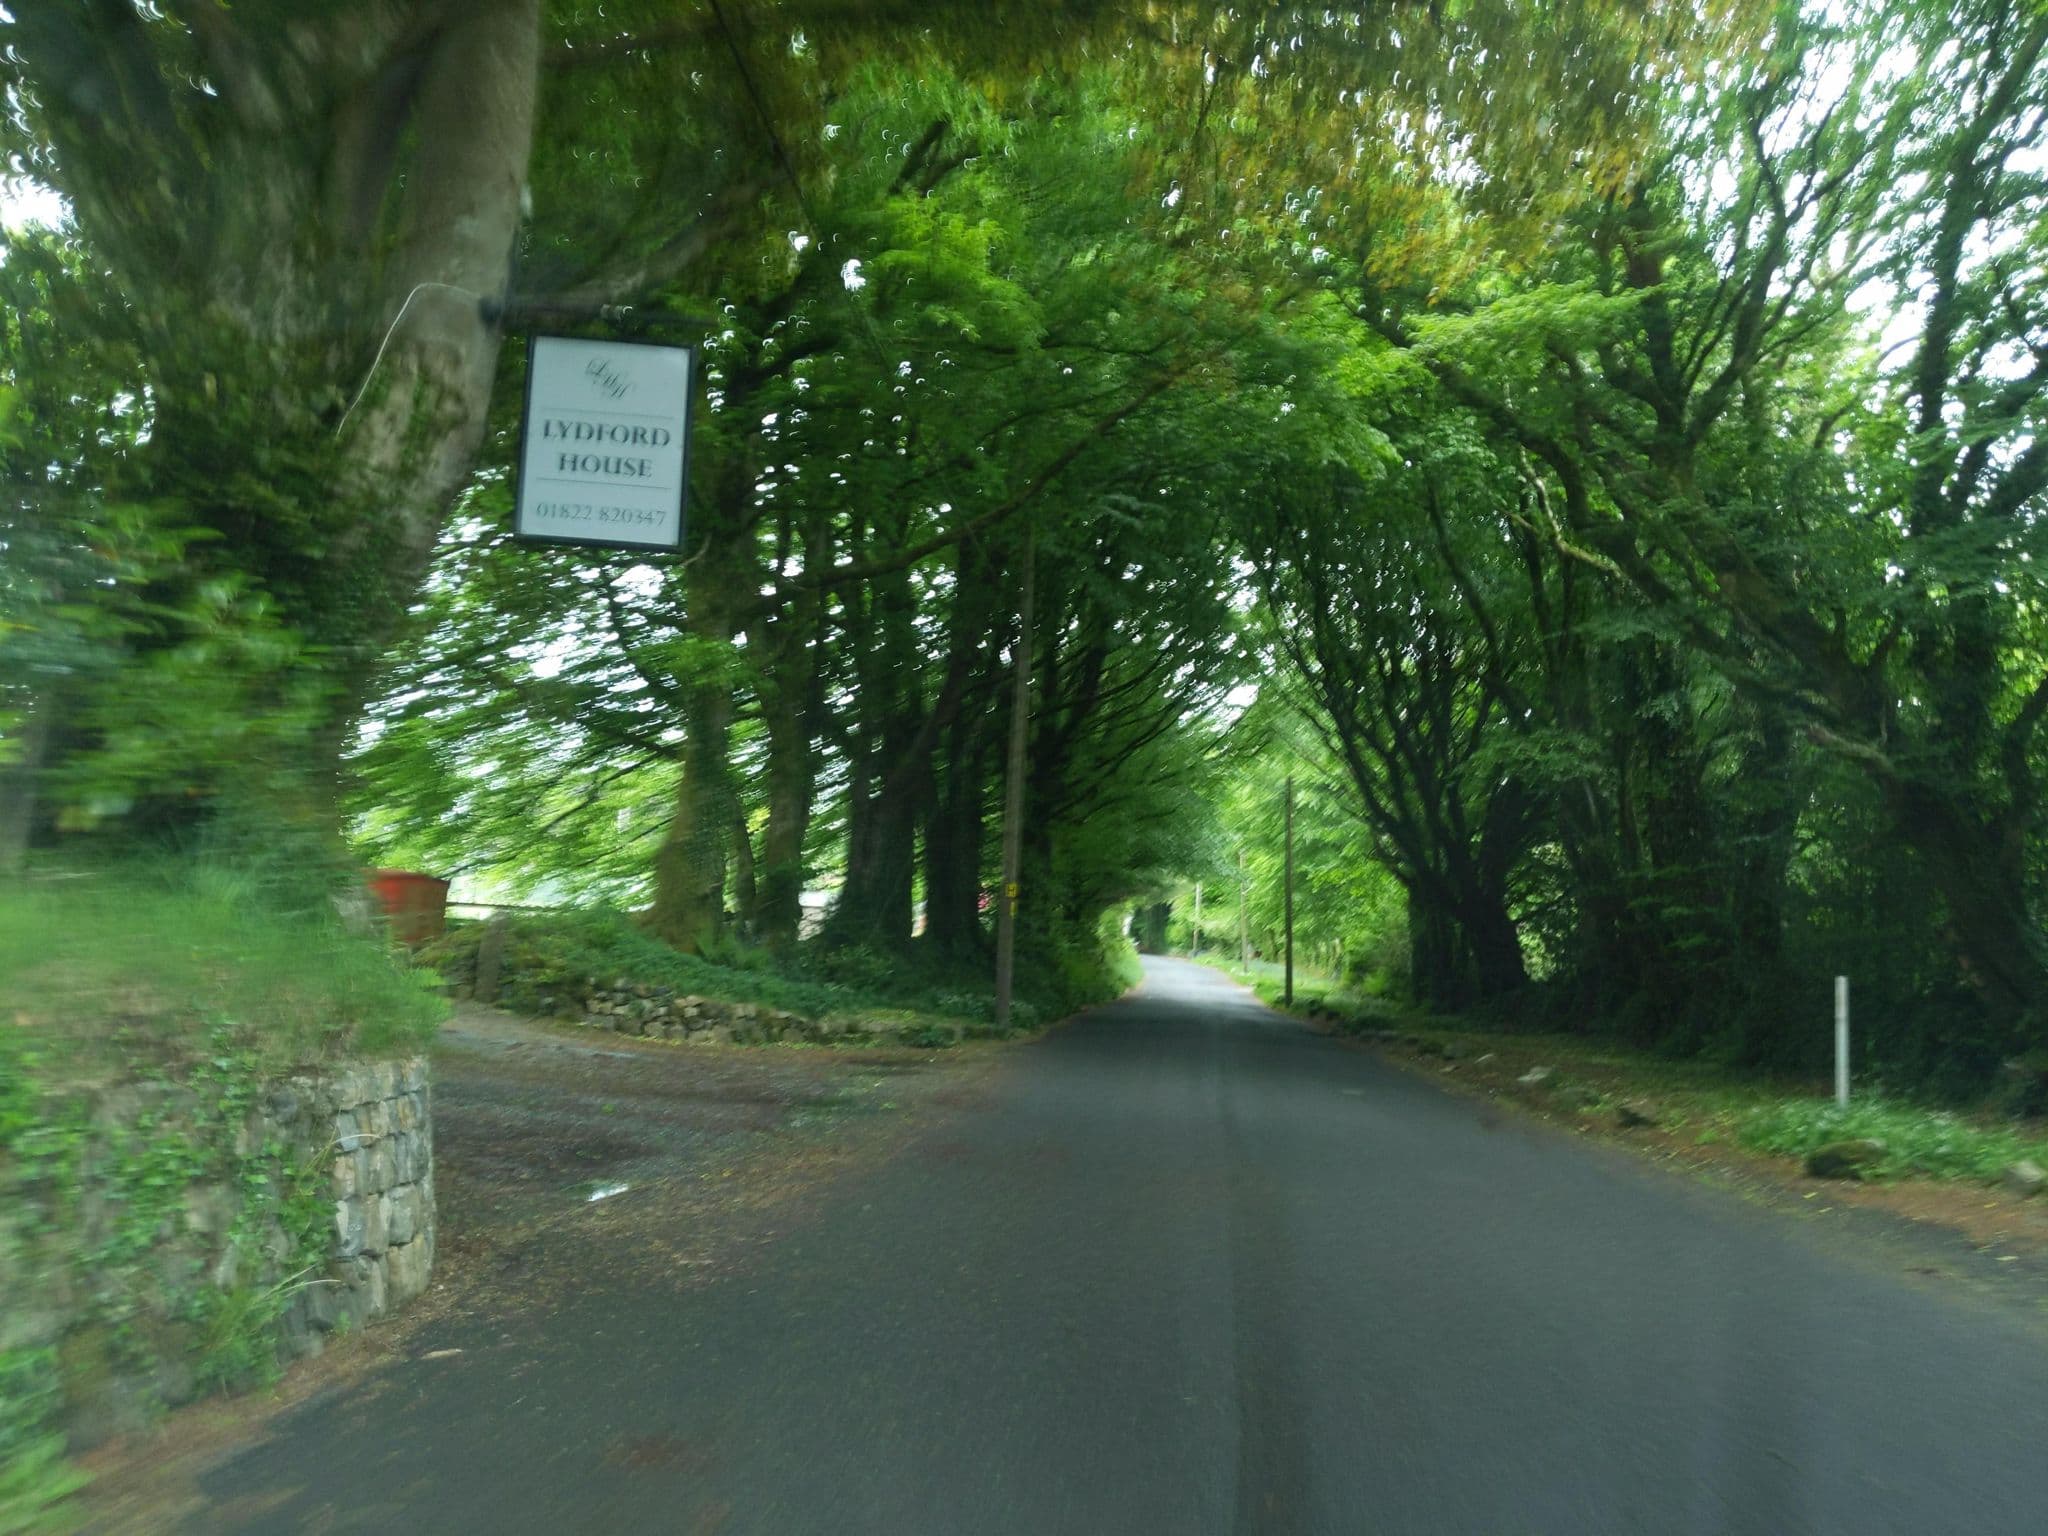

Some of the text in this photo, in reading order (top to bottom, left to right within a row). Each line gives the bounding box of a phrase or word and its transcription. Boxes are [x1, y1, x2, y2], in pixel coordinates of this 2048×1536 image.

[543, 420, 671, 447] LYDFORD
[559, 453, 653, 478] HOUSE
[536, 502, 667, 527] 01822 820347
